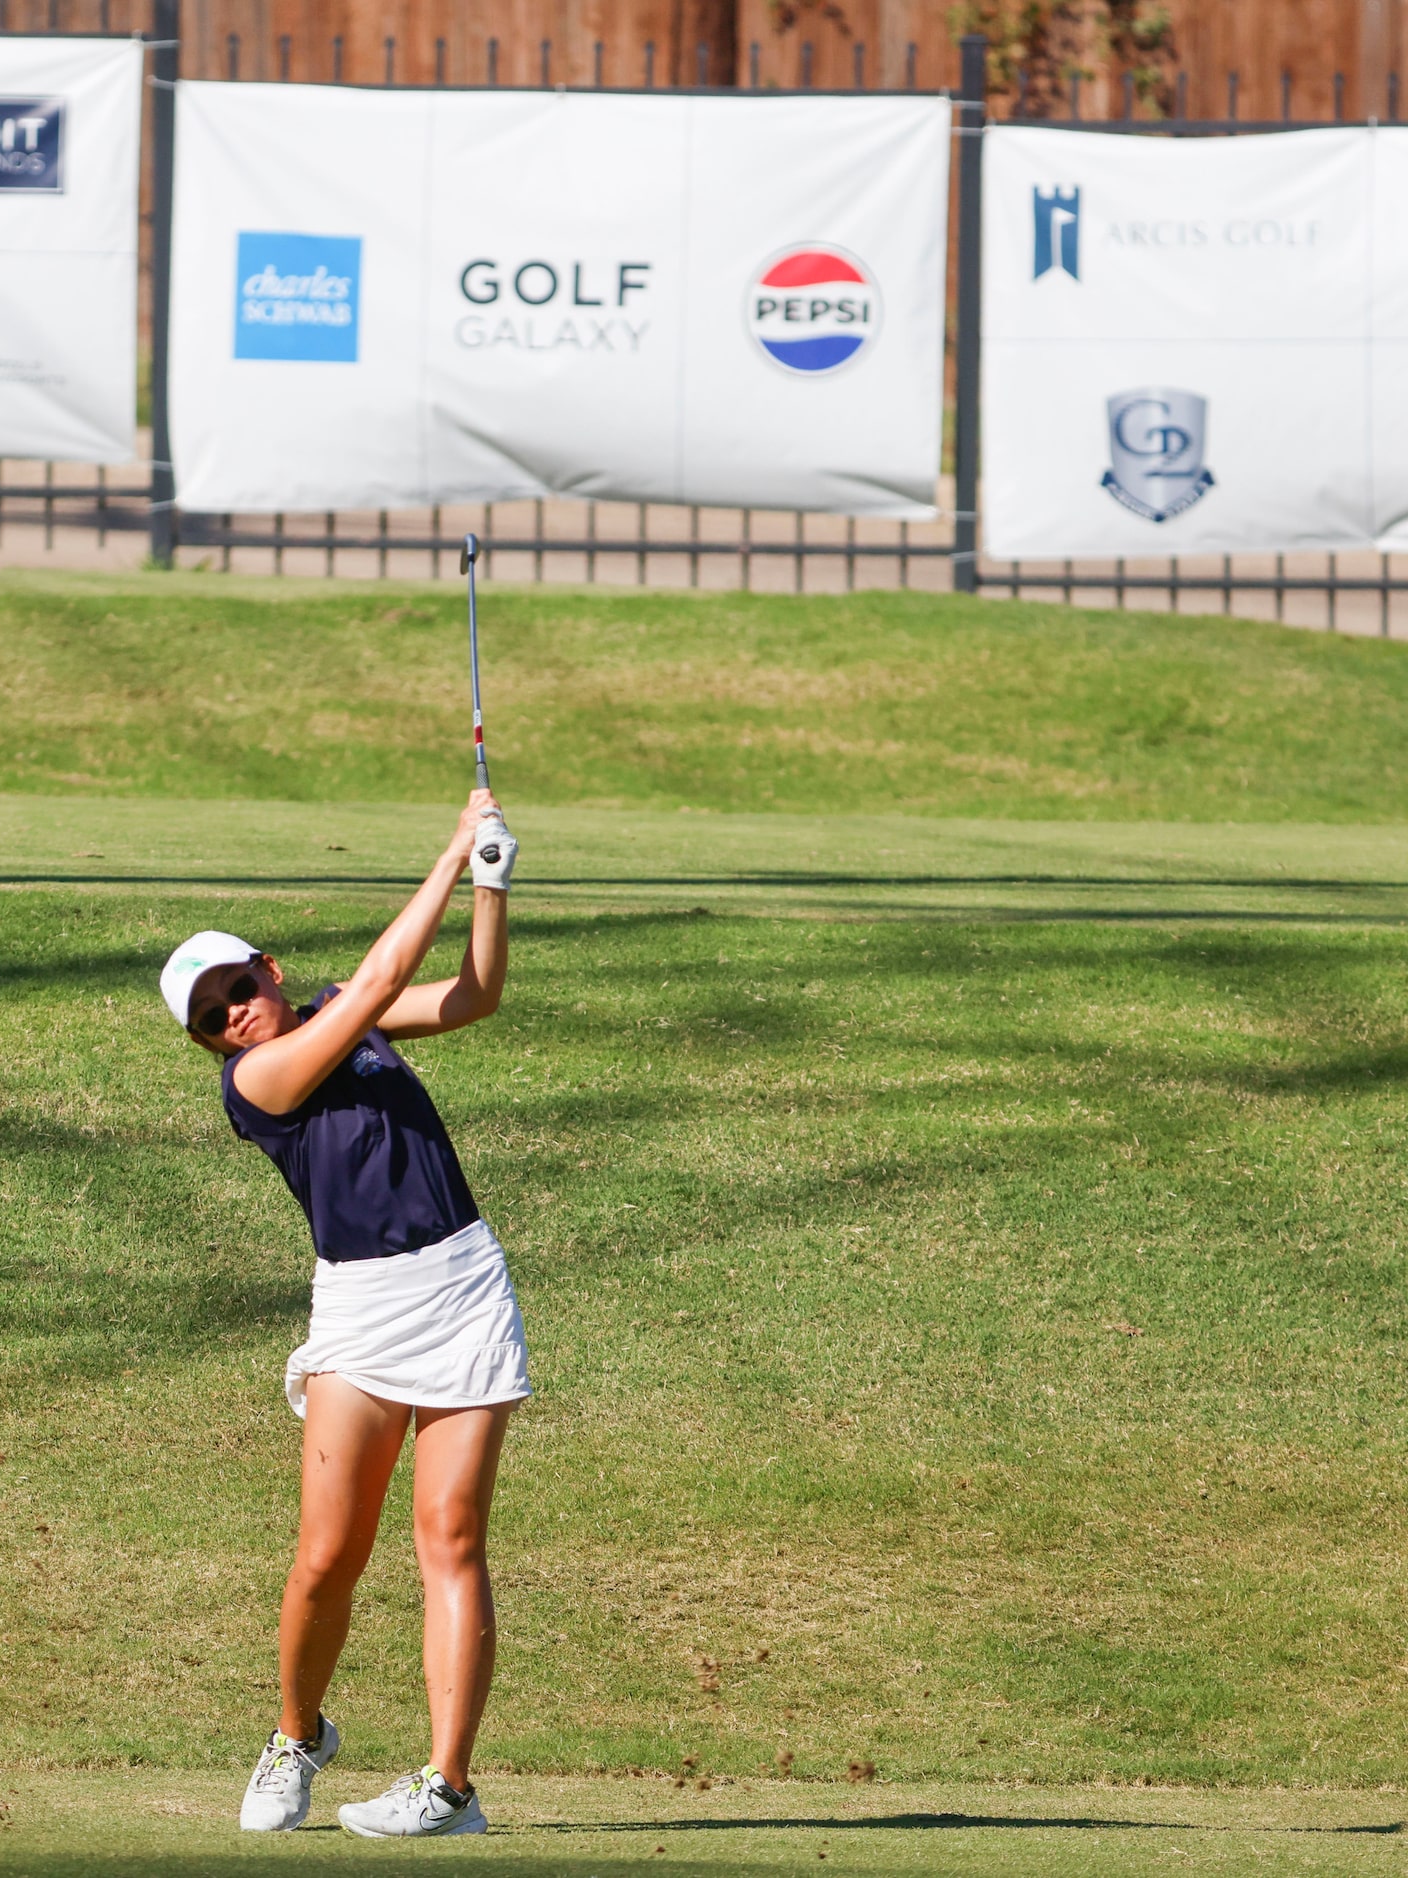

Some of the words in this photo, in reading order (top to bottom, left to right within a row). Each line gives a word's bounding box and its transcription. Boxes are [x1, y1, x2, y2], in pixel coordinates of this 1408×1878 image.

[1103, 219, 1209, 247] ARCIS
[1223, 219, 1322, 248] GOLF
[243, 264, 352, 299] charles
[461, 260, 651, 306] GOLF
[756, 298, 870, 325] PEPSI
[454, 315, 651, 350] GALAXY
